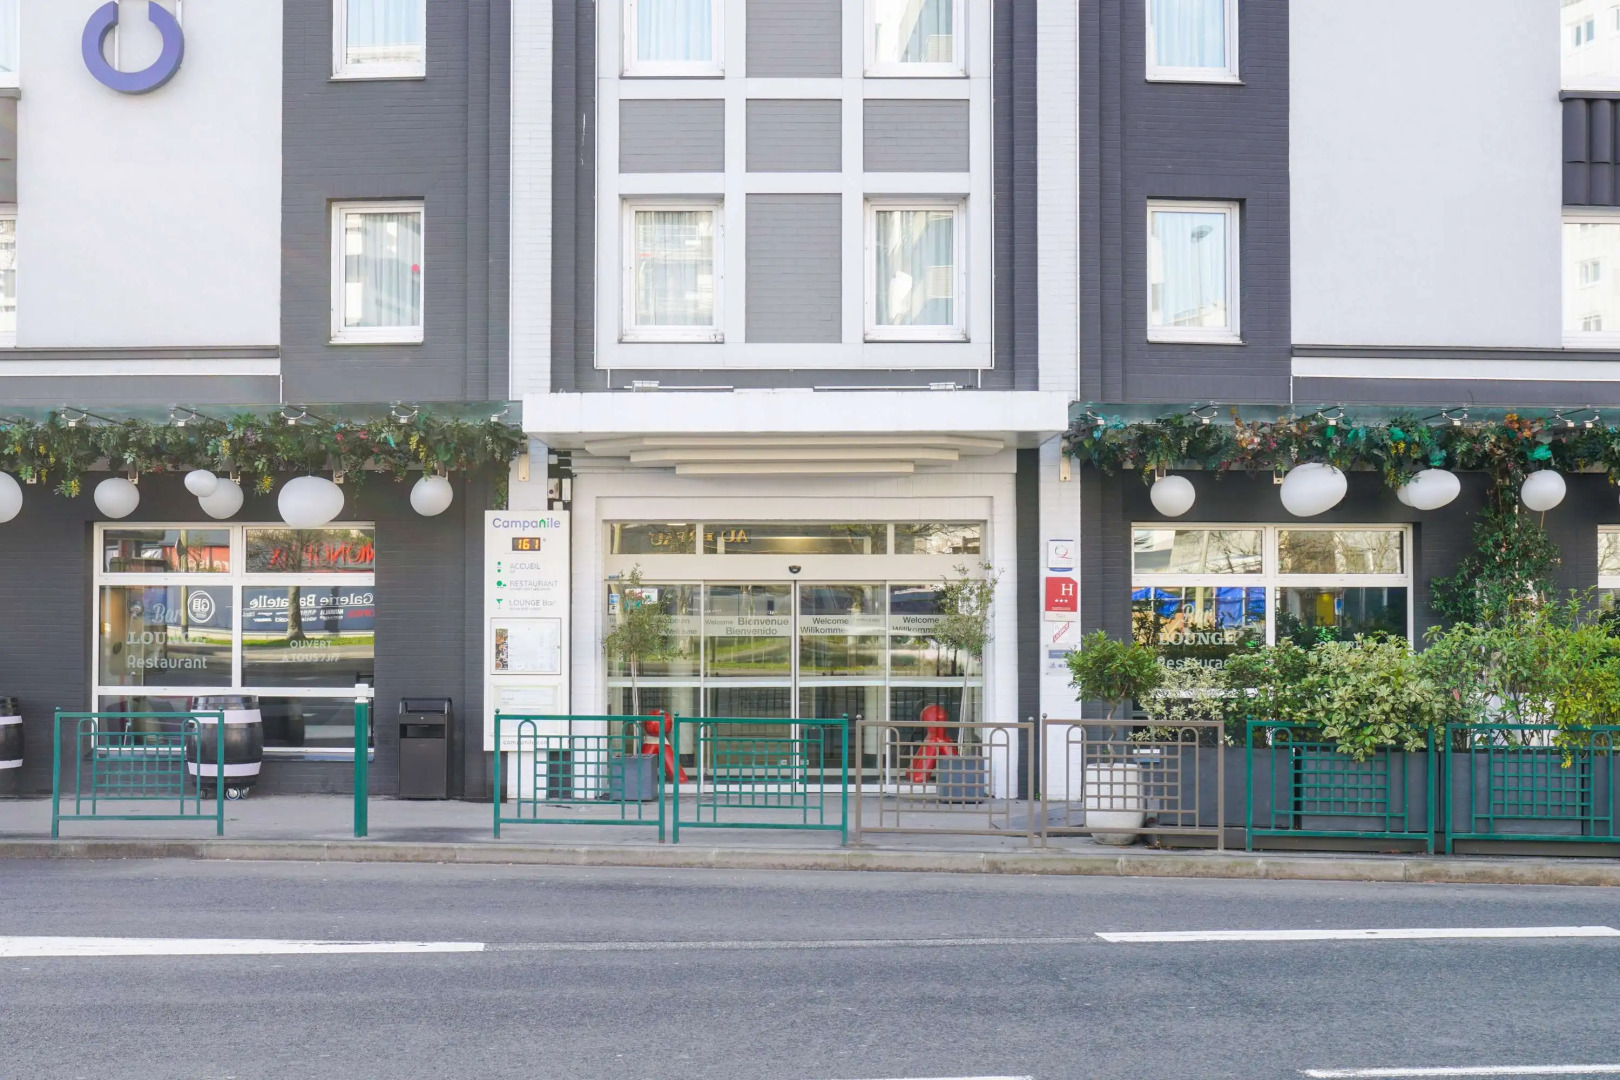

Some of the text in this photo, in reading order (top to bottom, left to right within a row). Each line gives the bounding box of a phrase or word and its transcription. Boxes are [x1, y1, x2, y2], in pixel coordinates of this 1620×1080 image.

[492, 517, 561, 531] Campanile
[509, 580, 558, 588] RESTAURANT
[1061, 583, 1074, 596] H
[509, 599, 556, 607] LOUNGE Bar
[152, 603, 181, 623] Bar
[738, 617, 789, 626] Bienvenue
[812, 617, 849, 625] Welcome
[903, 616, 940, 624] Welcome
[726, 627, 778, 635] Bienvenido
[1158, 631, 1238, 646] LOUNGE
[289, 640, 332, 649] OUVERT
[127, 655, 208, 669] Restaurant
[291, 653, 319, 662] TOUS
